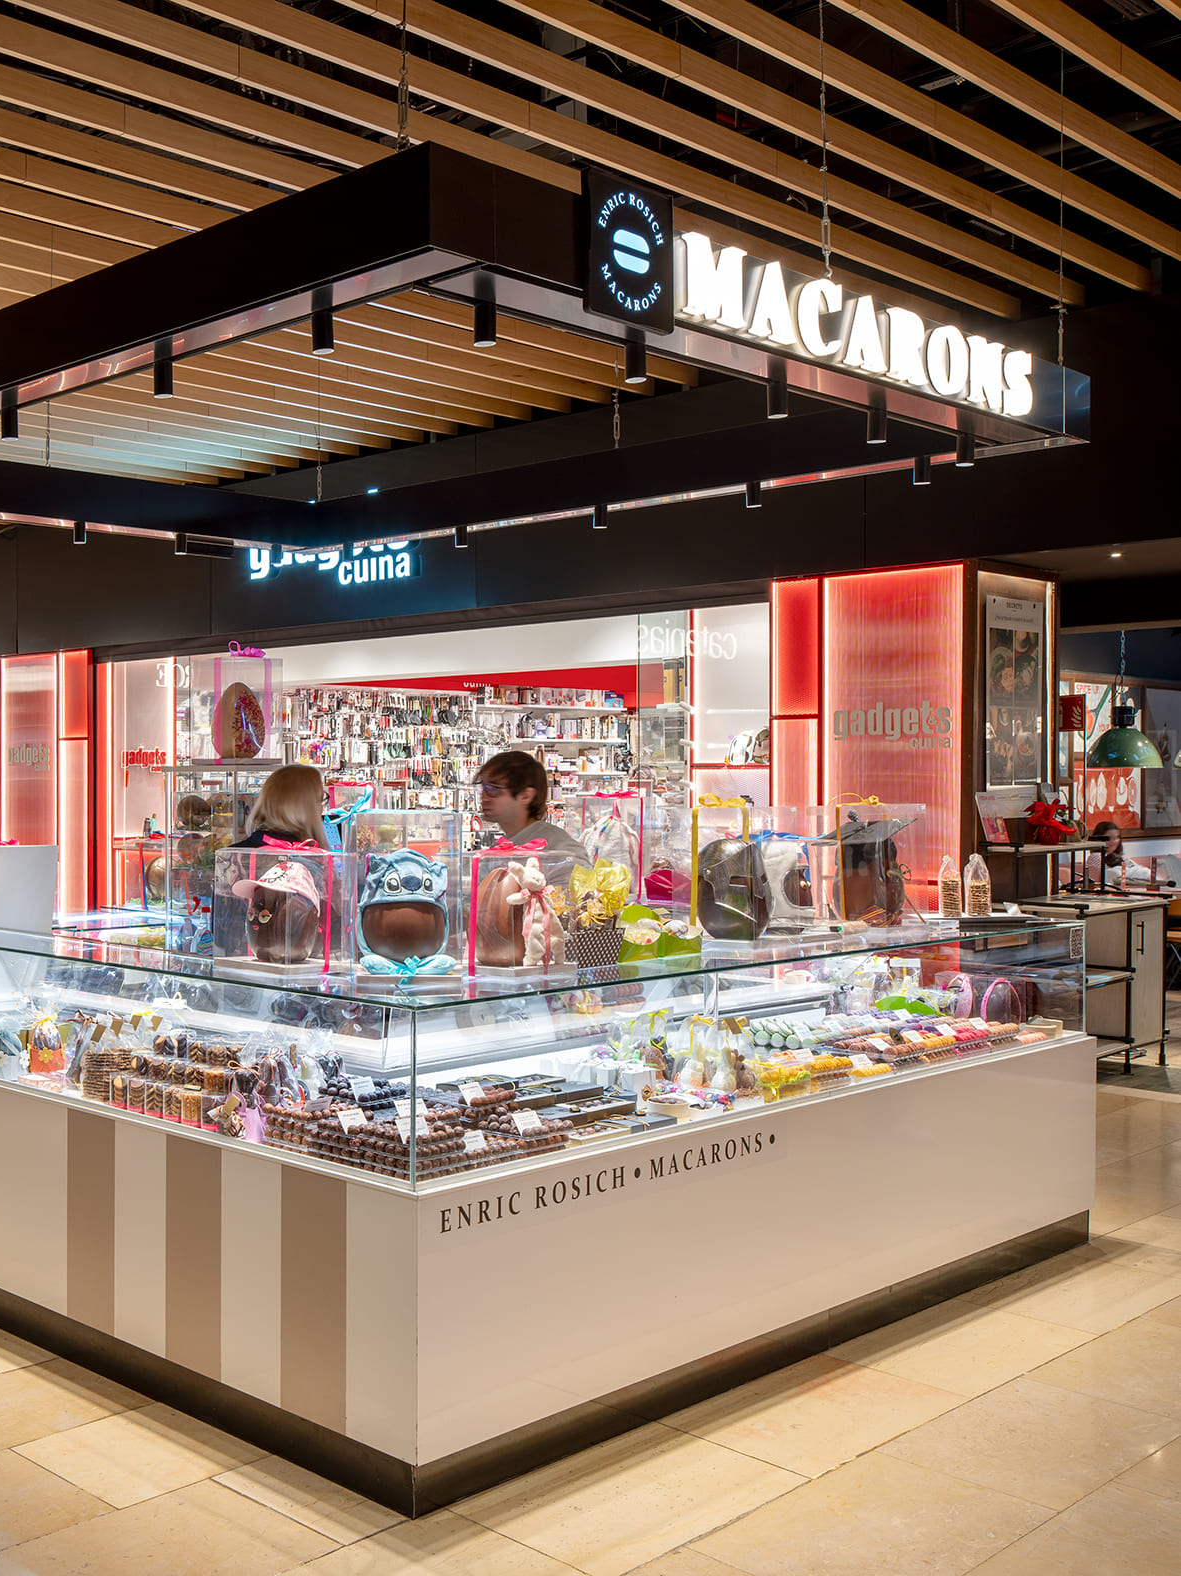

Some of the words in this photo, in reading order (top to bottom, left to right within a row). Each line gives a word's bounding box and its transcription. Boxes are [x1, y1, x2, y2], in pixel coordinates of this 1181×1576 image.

[598, 192, 625, 228] ENRIC
[628, 193, 664, 246] ROSICH
[602, 263, 661, 311] MACARONS
[680, 230, 1033, 418] MACARONS
[337, 552, 411, 585] cuina
[909, 737, 951, 749] cuina
[439, 1191, 522, 1234] ENRIC
[535, 1166, 625, 1209] ROSICH
[649, 1132, 763, 1180] MACARONS
